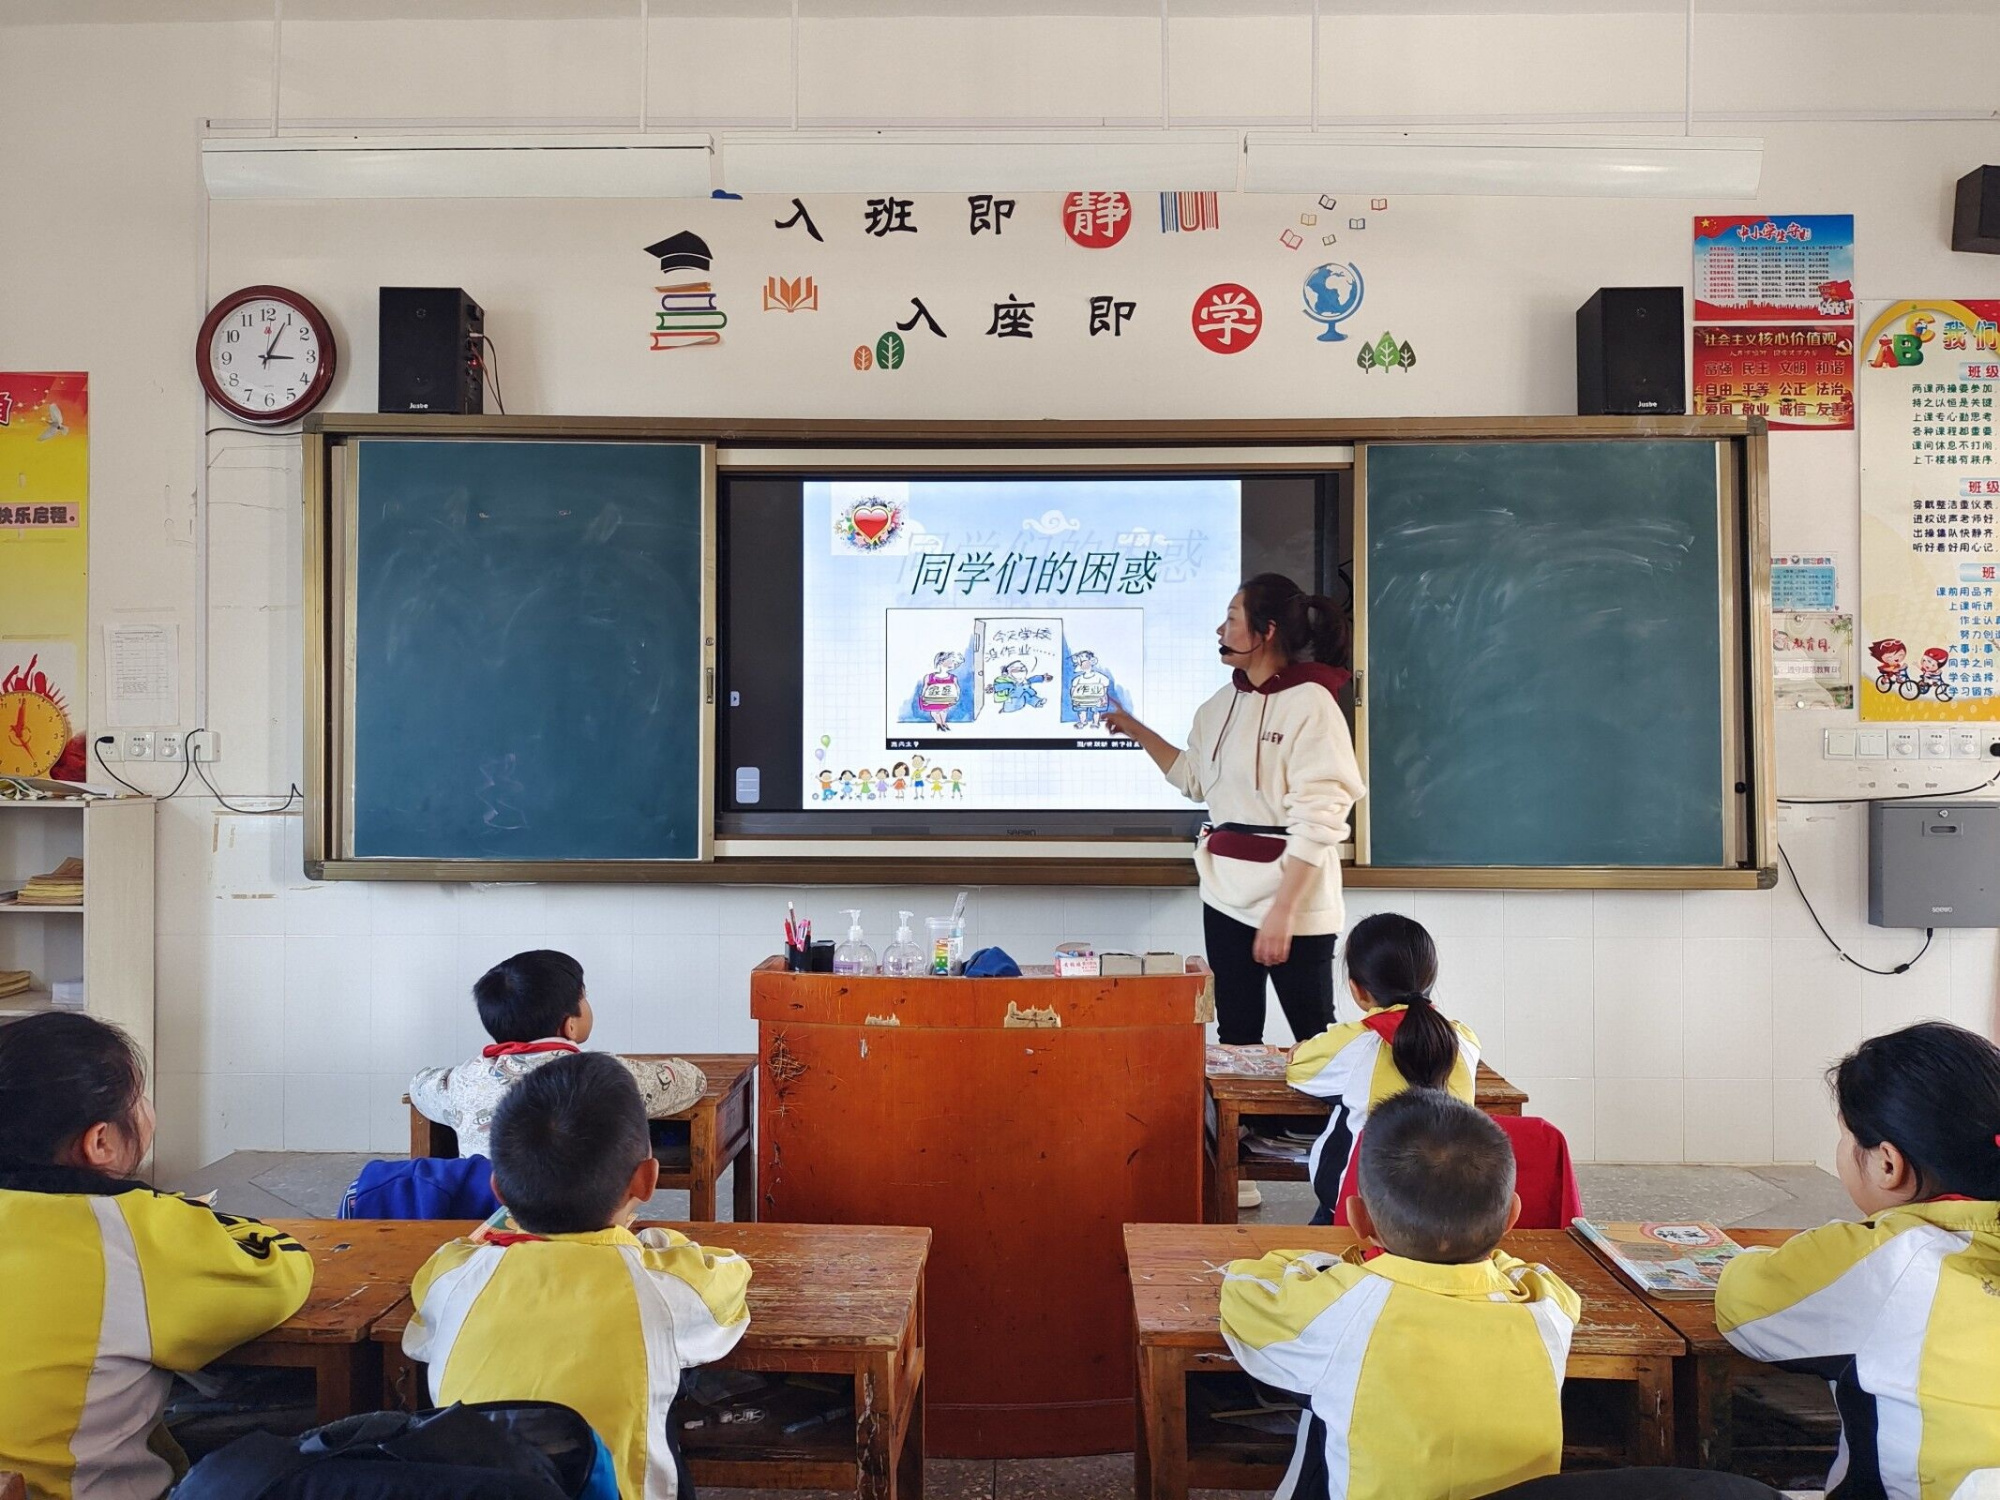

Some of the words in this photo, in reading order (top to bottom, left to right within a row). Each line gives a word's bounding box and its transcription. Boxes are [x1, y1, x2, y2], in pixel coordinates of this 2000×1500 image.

[241, 314, 253, 327] 11
[261, 308, 277, 322] 12
[287, 313, 292, 326] 1
[896, 293, 1257, 345] 入座即学
[226, 329, 240, 343] 10
[299, 326, 310, 341] 2
[1704, 332, 1837, 346] 社会主义核心价值观
[1943, 320, 1998, 350] 我们
[221, 351, 232, 365] 9
[306, 350, 316, 363] 3
[1705, 360, 1733, 376] 富强
[1742, 361, 1771, 376] 民主
[1779, 361, 1808, 376] 文明
[1816, 360, 1845, 376] 和谐
[1968, 365, 1999, 378] 班级
[229, 373, 240, 386] 8
[299, 372, 310, 385] 4
[244, 389, 253, 402] 7
[287, 388, 297, 400] 5
[1705, 382, 1732, 397] 自由
[1742, 382, 1770, 397] 平等
[1779, 382, 1807, 397] 公正
[1816, 382, 1844, 397] 法治
[264, 393, 275, 407] 6
[1705, 402, 1732, 415] 爱国
[1742, 402, 1769, 416] 敬业
[1779, 402, 1807, 416] 诚信
[1816, 402, 1845, 416] 友善
[1969, 481, 1999, 493] 班级
[911, 550, 1162, 595] 同学们的困惑
[1982, 566, 1995, 579] 班
[992, 627, 1052, 643] 今天学校
[1949, 643, 1993, 653] 大事小事
[1949, 659, 1993, 668] 同学之间
[1077, 685, 1102, 695] 作业
